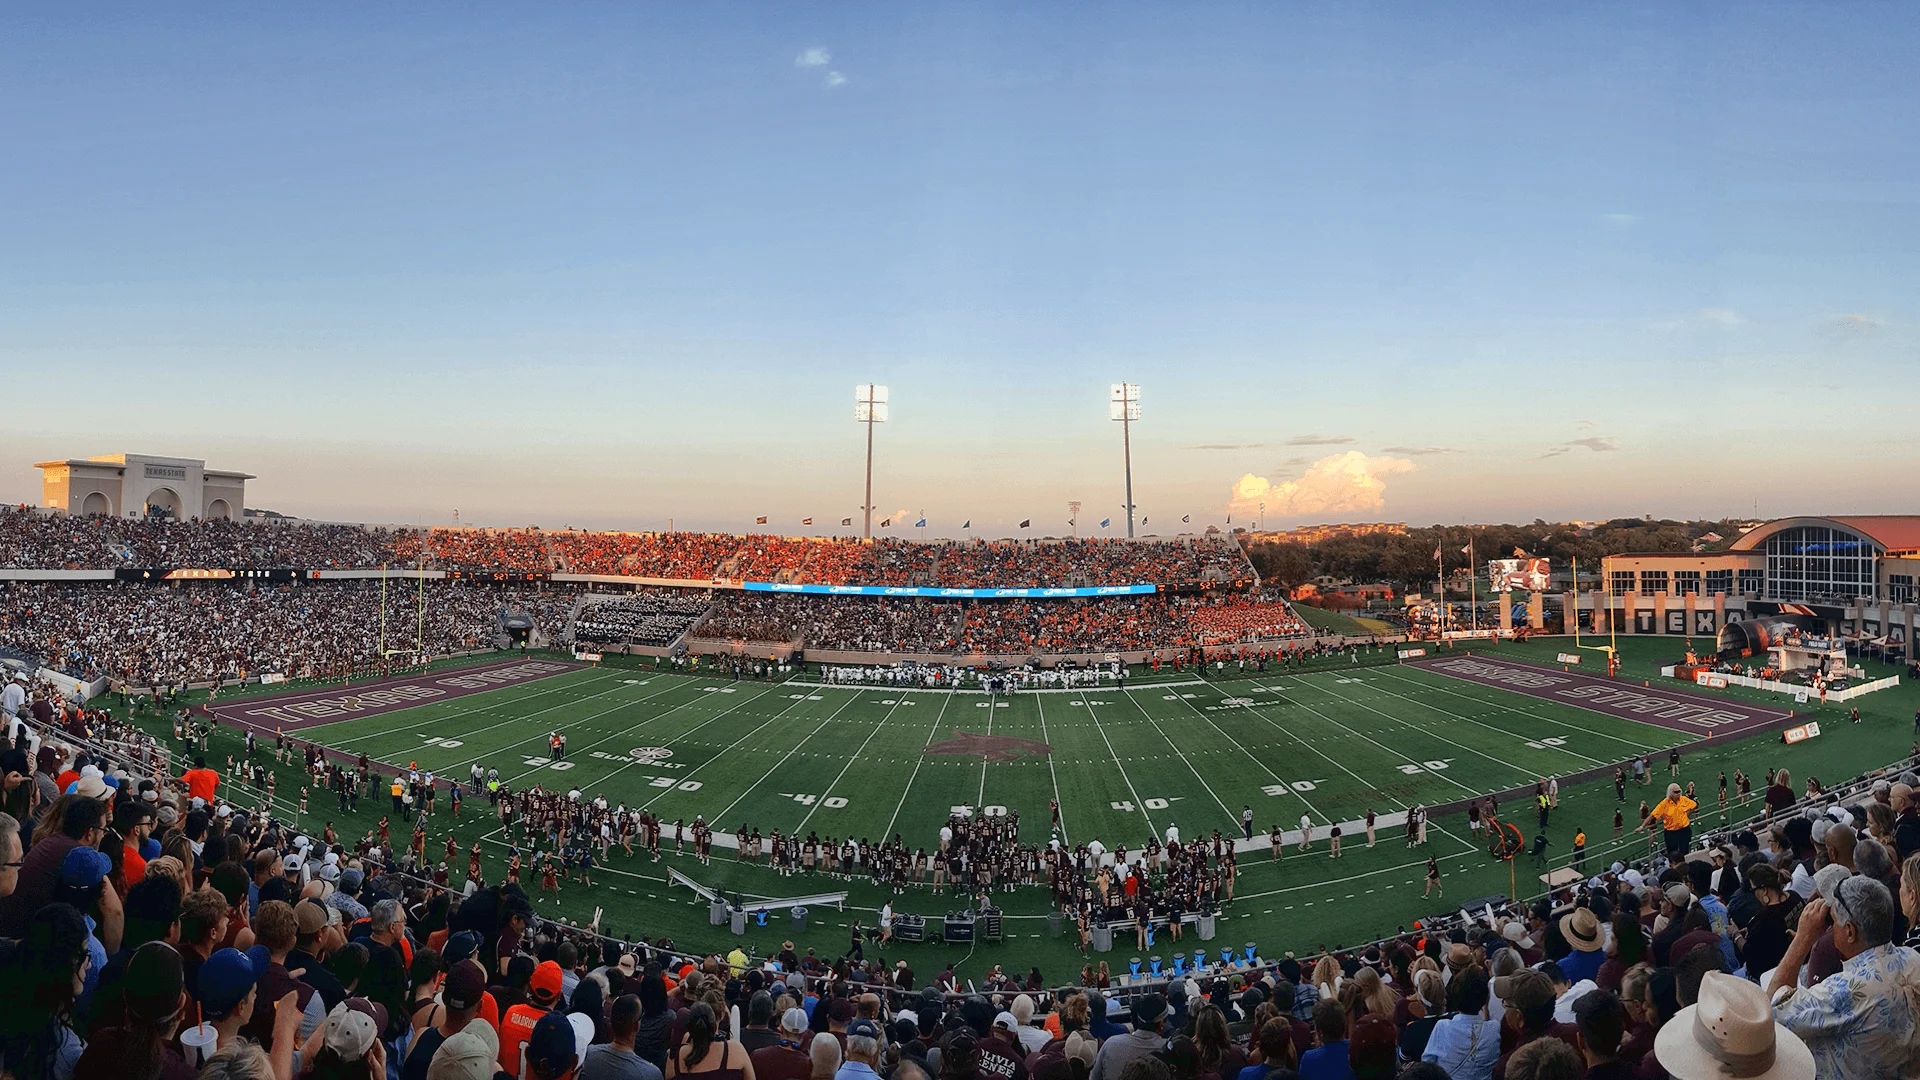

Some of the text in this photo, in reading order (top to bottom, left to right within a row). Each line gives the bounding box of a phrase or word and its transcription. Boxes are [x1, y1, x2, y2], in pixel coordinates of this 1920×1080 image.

[146, 467, 186, 478] TEXAS STATE
[245, 660, 569, 722] TEXAS STATE
[1431, 659, 1749, 728] TEXAS STATE
[1524, 737, 1567, 750] 10
[523, 756, 576, 771] 20
[589, 751, 686, 769] SUN BELT
[1396, 759, 1449, 775] 20
[648, 776, 703, 791] 30
[1260, 780, 1317, 797] 30
[794, 793, 849, 808] 40
[1110, 797, 1169, 812] 40
[950, 805, 1007, 817] 50
[979, 1058, 1014, 1078] ENEE
